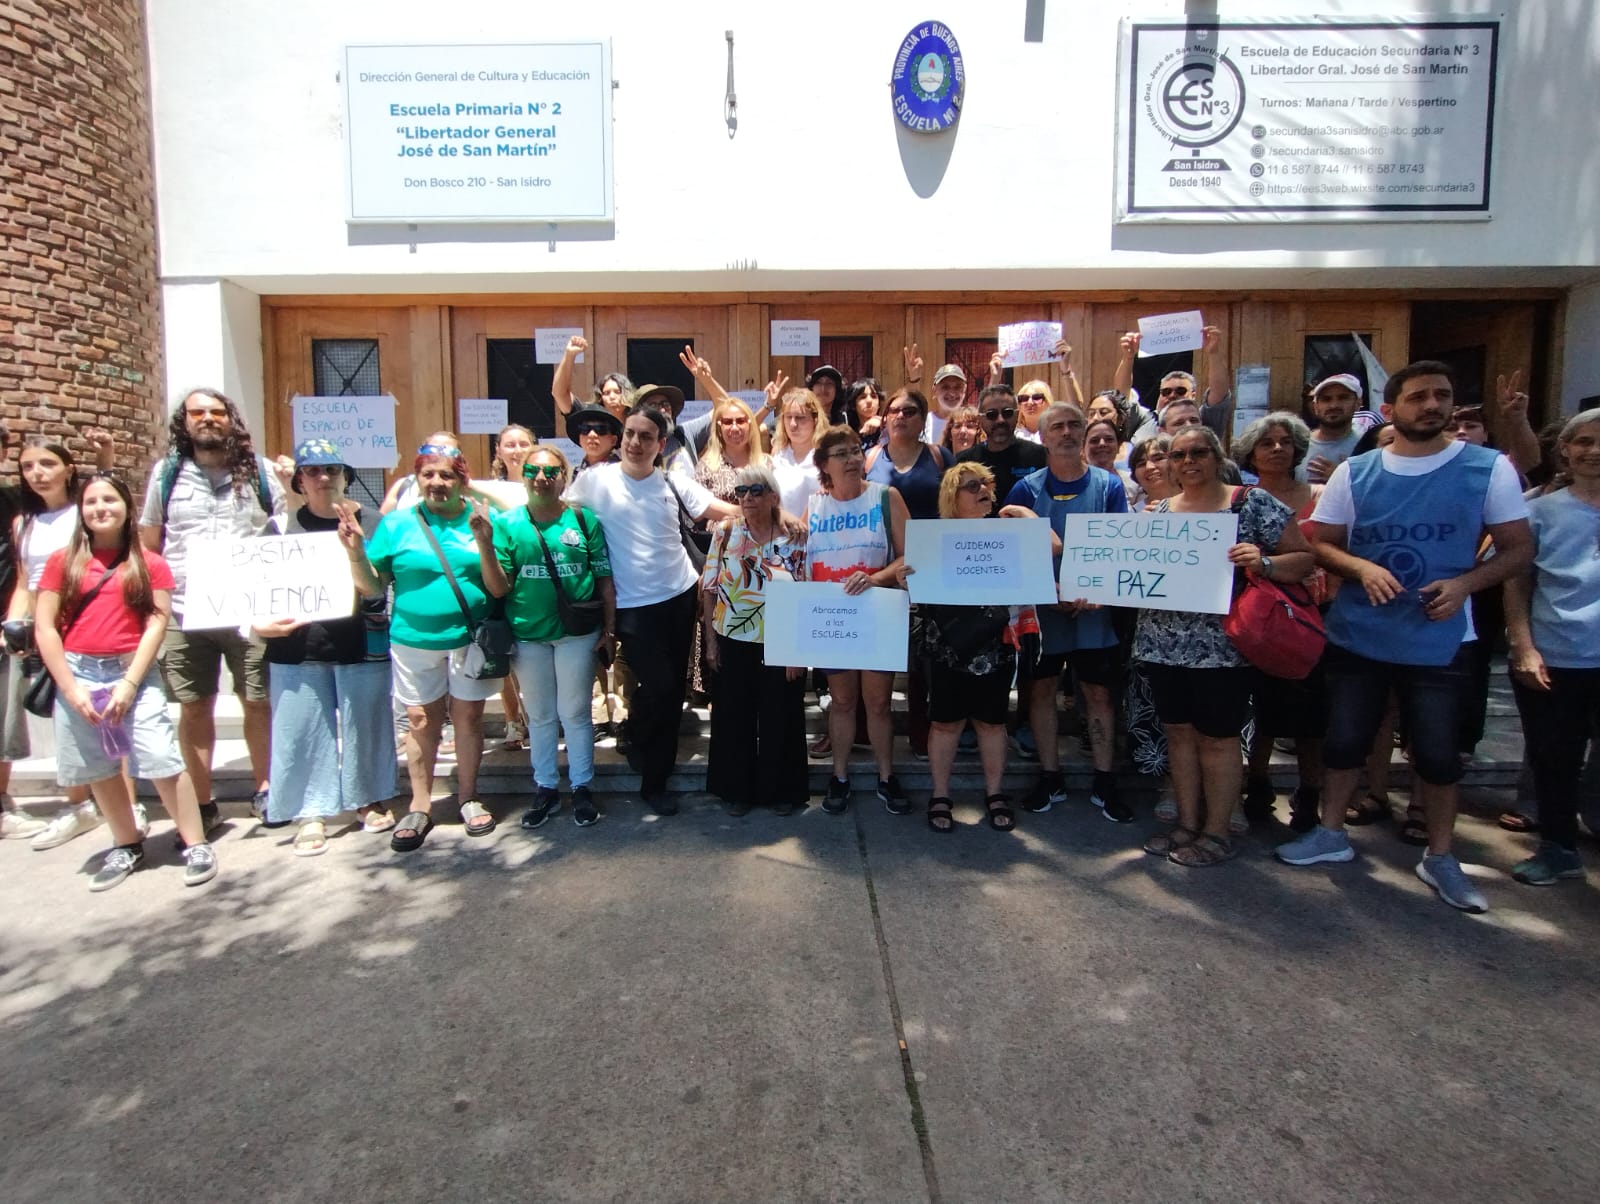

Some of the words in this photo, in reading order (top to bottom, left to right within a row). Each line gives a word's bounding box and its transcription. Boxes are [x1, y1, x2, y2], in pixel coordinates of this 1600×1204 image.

[894, 34, 920, 80] PROVINCIA
[920, 27, 930, 38] DE
[932, 23, 958, 54] BUENOS
[953, 56, 963, 81] AIRES
[1165, 53, 1174, 61] de
[1241, 46, 1289, 57] Escuela
[1294, 46, 1308, 57] de
[1312, 45, 1376, 57] Educación
[1381, 46, 1450, 57] Secundaria
[1473, 45, 1479, 56] 3
[1150, 62, 1164, 79] José
[1251, 64, 1313, 76] Libertador
[1318, 64, 1346, 75] Gral.
[1351, 63, 1379, 75] José
[1384, 64, 1399, 75] de
[1403, 64, 1425, 75] San
[360, 71, 411, 82] Dirección
[415, 71, 457, 82] General
[461, 72, 475, 81] de
[478, 71, 518, 81] Cultura
[522, 72, 527, 83] y
[532, 70, 590, 81] Educación
[1144, 82, 1152, 101] Gral.
[1260, 97, 1302, 108] Turnos:
[1306, 96, 1348, 107] Mañana
[1359, 97, 1388, 107] Tarde
[1399, 97, 1457, 108] Vespertino
[390, 103, 450, 116] Escuela
[456, 103, 523, 116] Primaria
[552, 103, 561, 115] 2
[895, 95, 941, 131] ESCUELA
[953, 95, 961, 107] 2
[1146, 104, 1172, 141] Libertador
[495, 126, 556, 138] General
[398, 144, 433, 157] José
[438, 144, 458, 157] de
[463, 144, 492, 156] San
[1193, 161, 1220, 170] Isidro
[1268, 165, 1279, 175] 11
[1282, 165, 1289, 175] 6
[1292, 165, 1312, 175] 587
[1314, 164, 1339, 175] 8744
[1353, 164, 1364, 175] 11
[1367, 165, 1374, 175] 6
[1377, 164, 1396, 174] 587
[1399, 164, 1425, 174] 8743
[405, 178, 427, 187] Don
[430, 178, 464, 187] Bosco
[468, 177, 486, 187] 210
[497, 177, 517, 187] San
[521, 177, 551, 187] Isidro
[1170, 177, 1197, 187] Desde
[1201, 176, 1221, 187] 1940
[1024, 349, 1045, 361] PAZ
[303, 402, 358, 414] ESCUELA
[302, 420, 350, 432] ESPACIO
[358, 418, 375, 429] DE
[359, 437, 366, 446] Y
[372, 436, 395, 448] PAZ
[810, 512, 867, 536] Suteba
[1088, 519, 1219, 543] ESCUELAS:
[1351, 523, 1456, 545] SADOP
[955, 541, 1004, 549] CUIDEMOS
[232, 539, 304, 567] BASTA
[1070, 547, 1200, 565] TERRITORIOS
[526, 568, 535, 576] el
[957, 566, 1006, 574] DOCENTES
[1077, 576, 1103, 587] DE
[1117, 570, 1167, 598] PAZ
[812, 606, 857, 614] Abracemos
[833, 618, 844, 626] las
[812, 630, 858, 638] ESCUELAS
